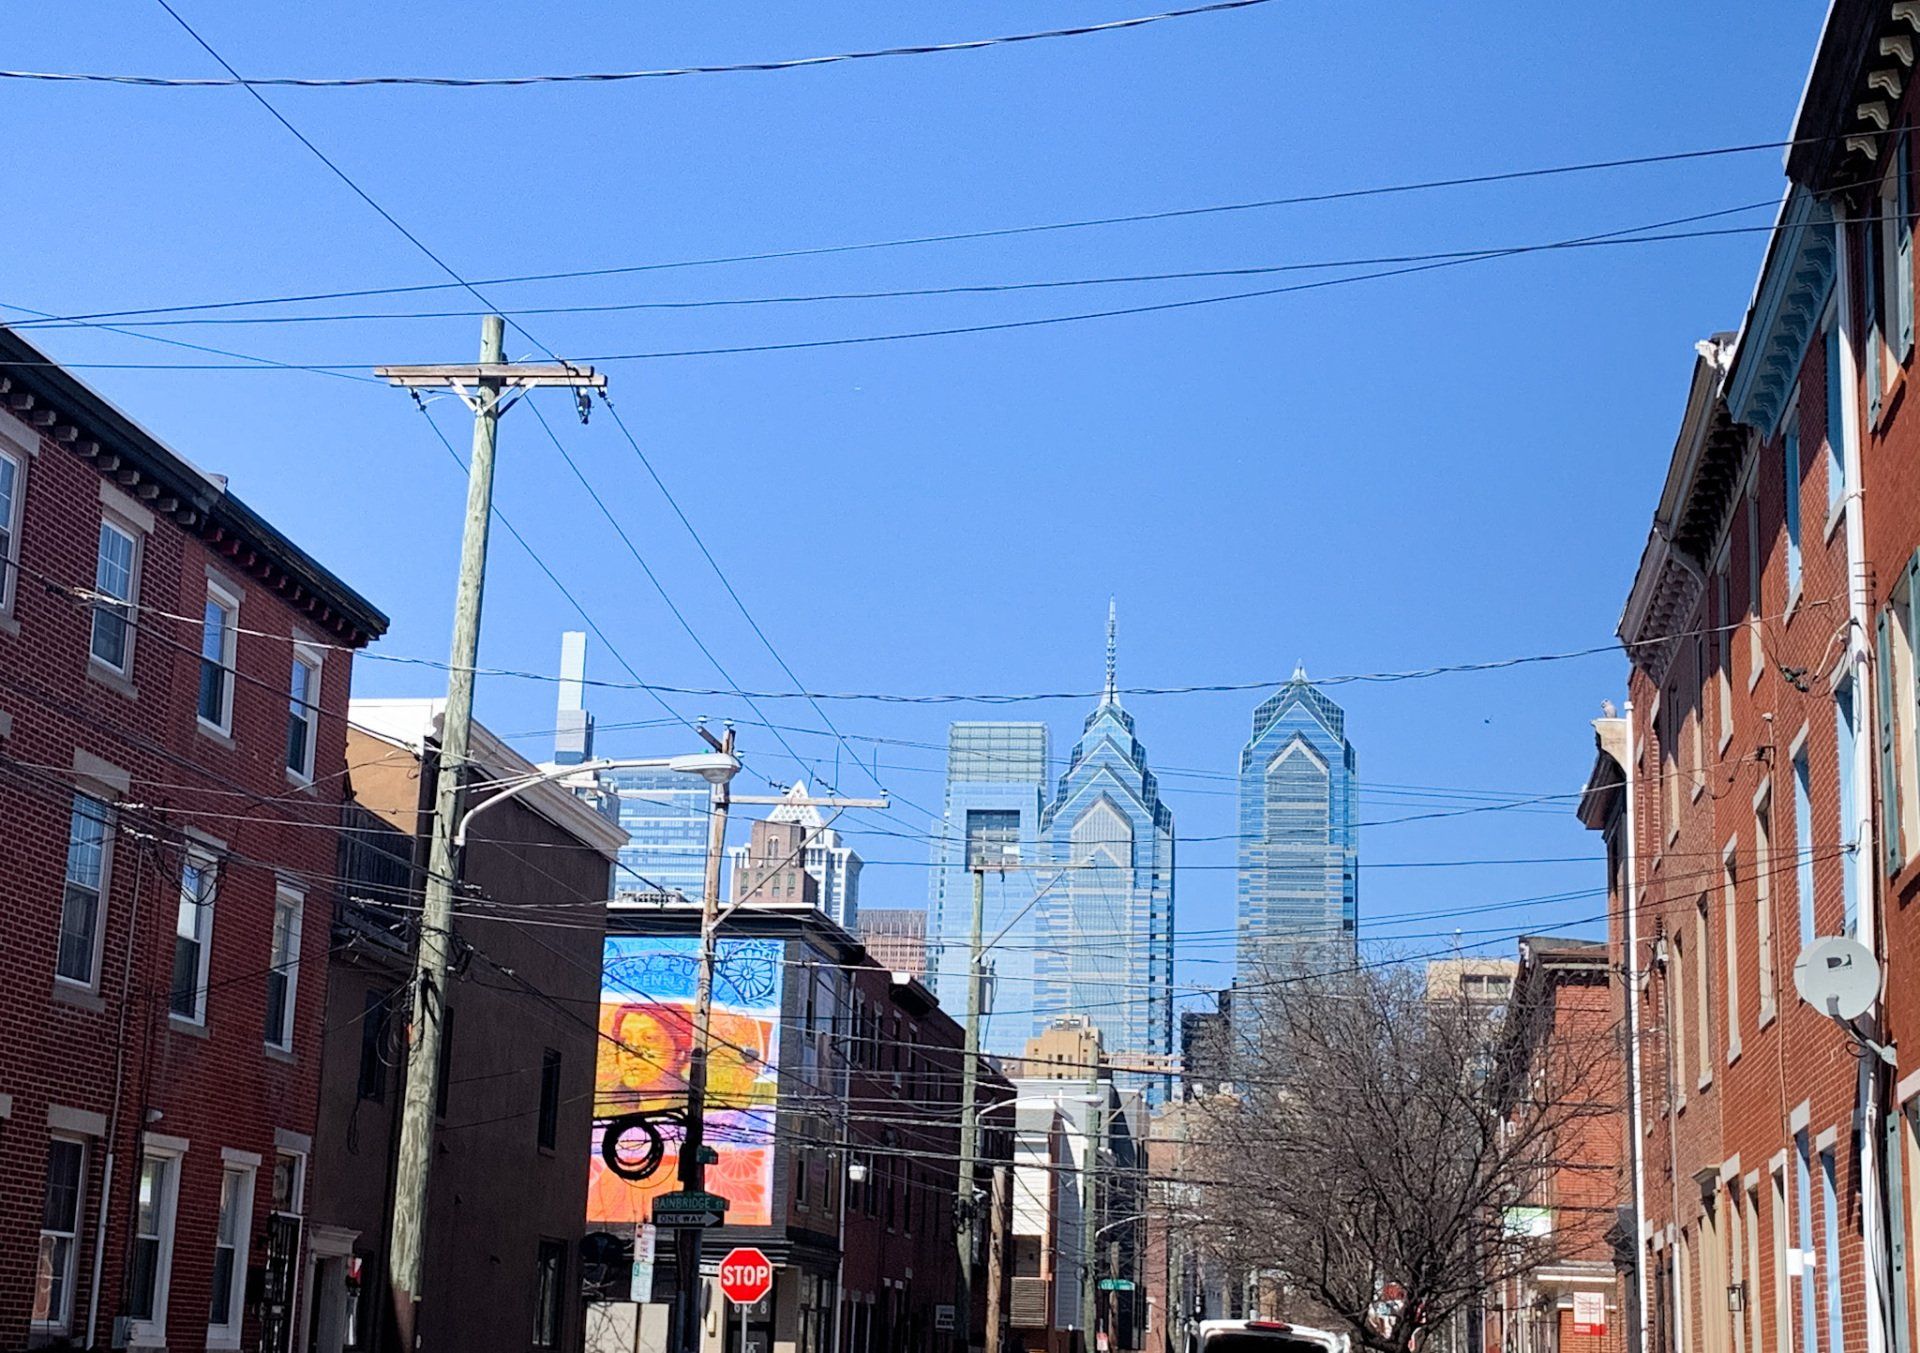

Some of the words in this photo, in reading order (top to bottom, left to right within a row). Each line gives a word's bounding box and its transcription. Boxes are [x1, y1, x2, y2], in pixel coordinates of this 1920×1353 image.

[653, 1197, 712, 1210] BAINBRIDGE
[660, 1215, 679, 1224] ONE
[682, 1216, 703, 1224] WAY
[723, 1266, 769, 1286] STOP
